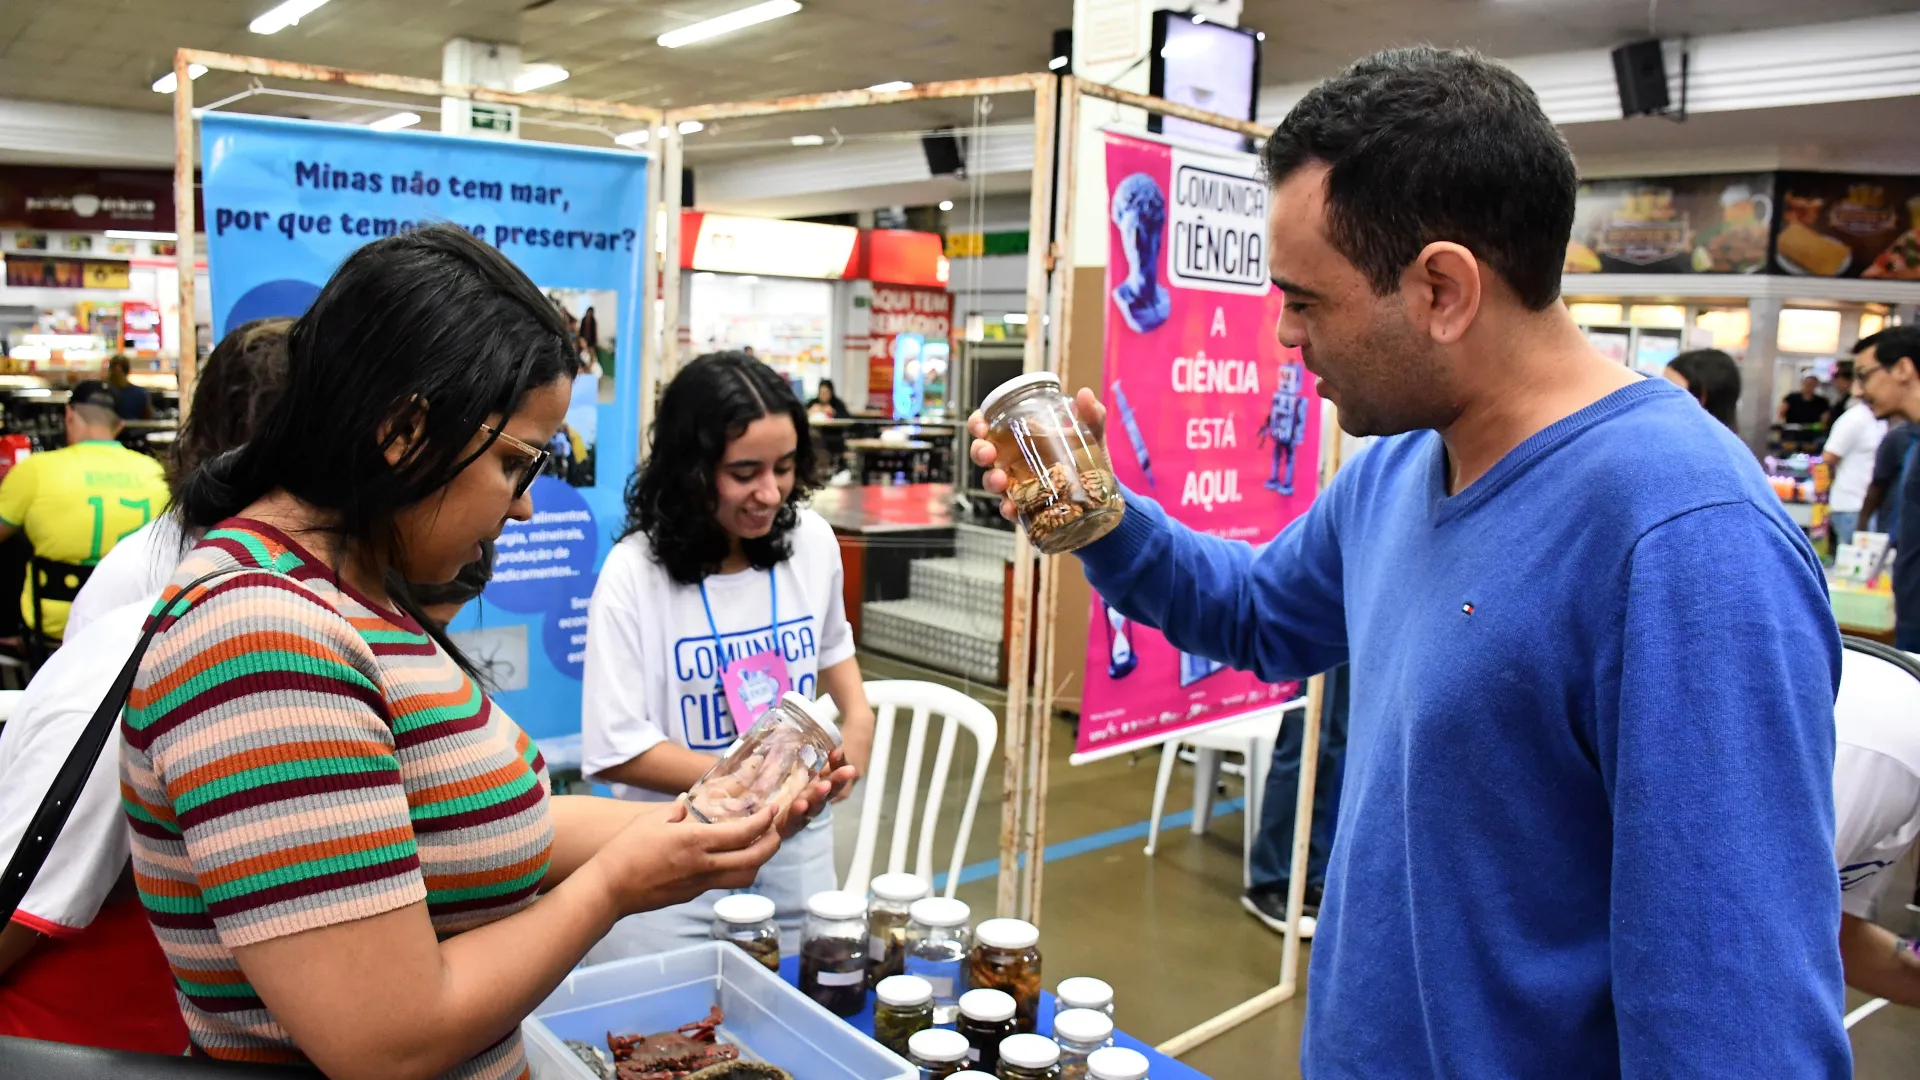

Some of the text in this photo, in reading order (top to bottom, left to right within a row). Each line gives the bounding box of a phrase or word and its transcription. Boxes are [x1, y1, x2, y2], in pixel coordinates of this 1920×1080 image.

[295, 160, 570, 213] Minas não tem mar,
[1177, 175, 1265, 218] COMUNICA
[215, 207, 270, 237] por
[278, 211, 332, 240] que
[494, 223, 637, 252] preservar?
[1175, 214, 1262, 278] CIÊNCIA
[1209, 306, 1227, 338] A
[1171, 349, 1260, 395] CIÊNCIA
[1185, 411, 1237, 450] ESTÁ
[1180, 468, 1243, 513] AQUI.
[553, 546, 570, 560] de
